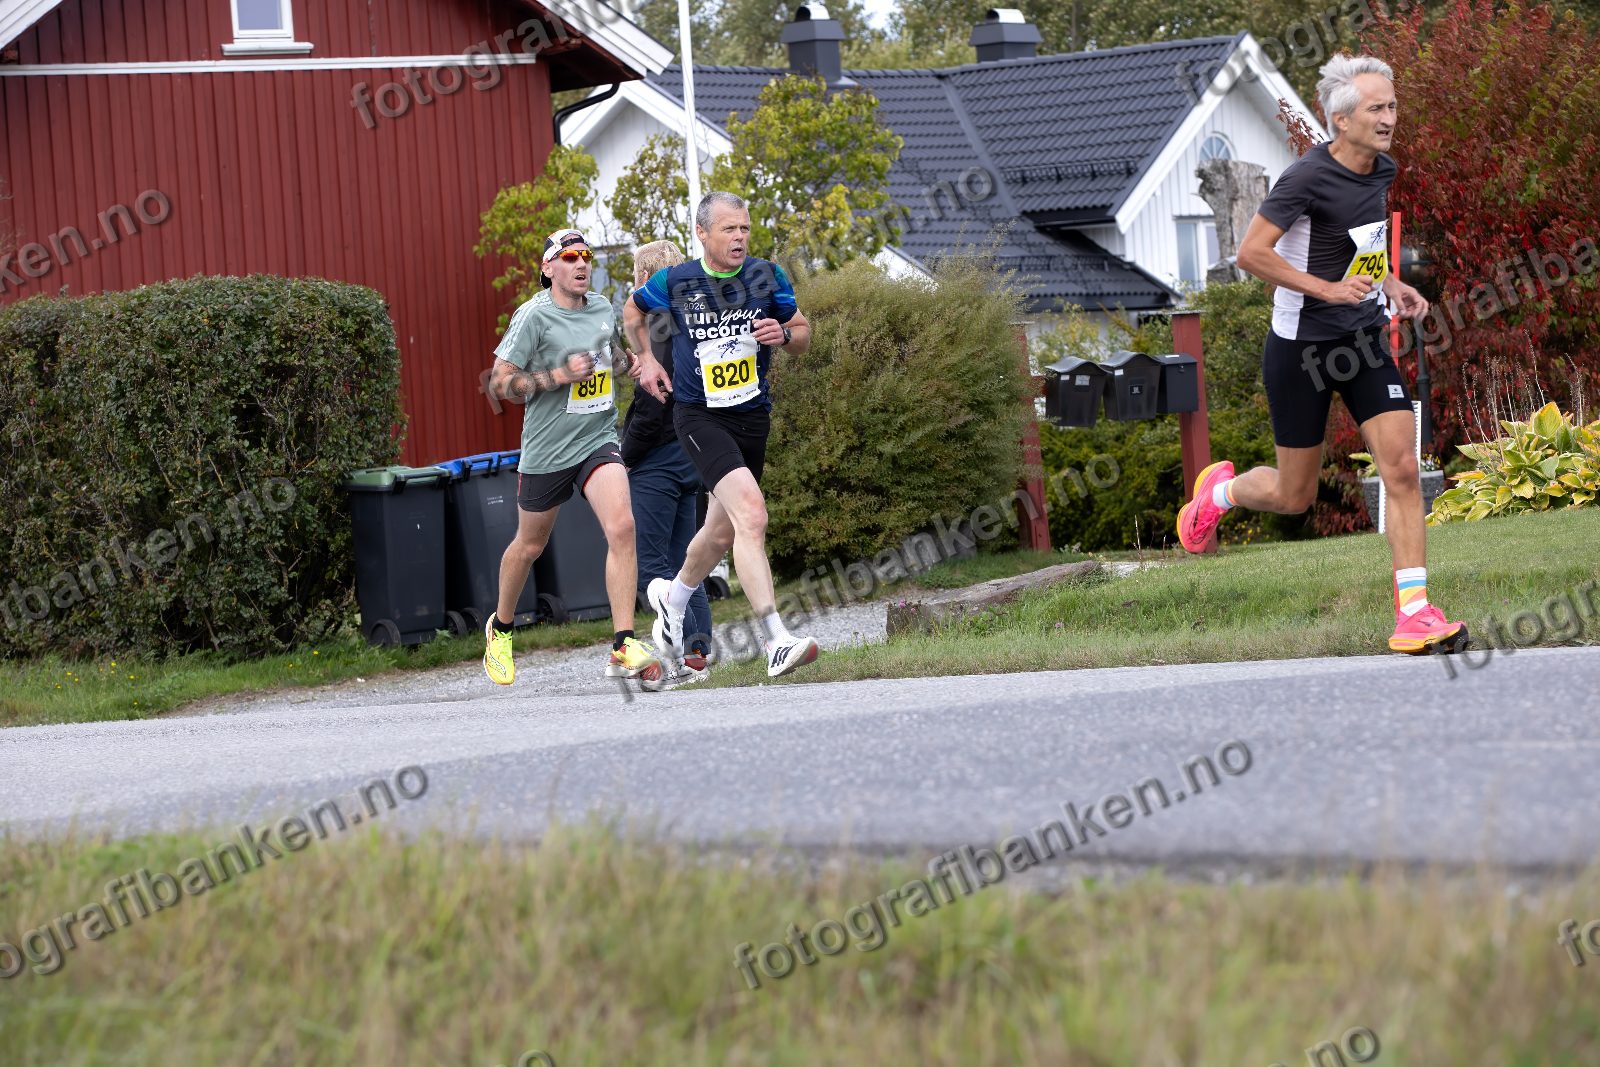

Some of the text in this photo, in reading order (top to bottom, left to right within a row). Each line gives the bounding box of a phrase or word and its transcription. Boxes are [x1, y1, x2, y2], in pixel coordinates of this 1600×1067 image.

[1357, 252, 1385, 280] 799
[683, 302, 706, 311] 2026
[685, 307, 762, 330] run your
[688, 320, 751, 340] record
[577, 371, 607, 398] 897
[711, 359, 750, 389] 820
